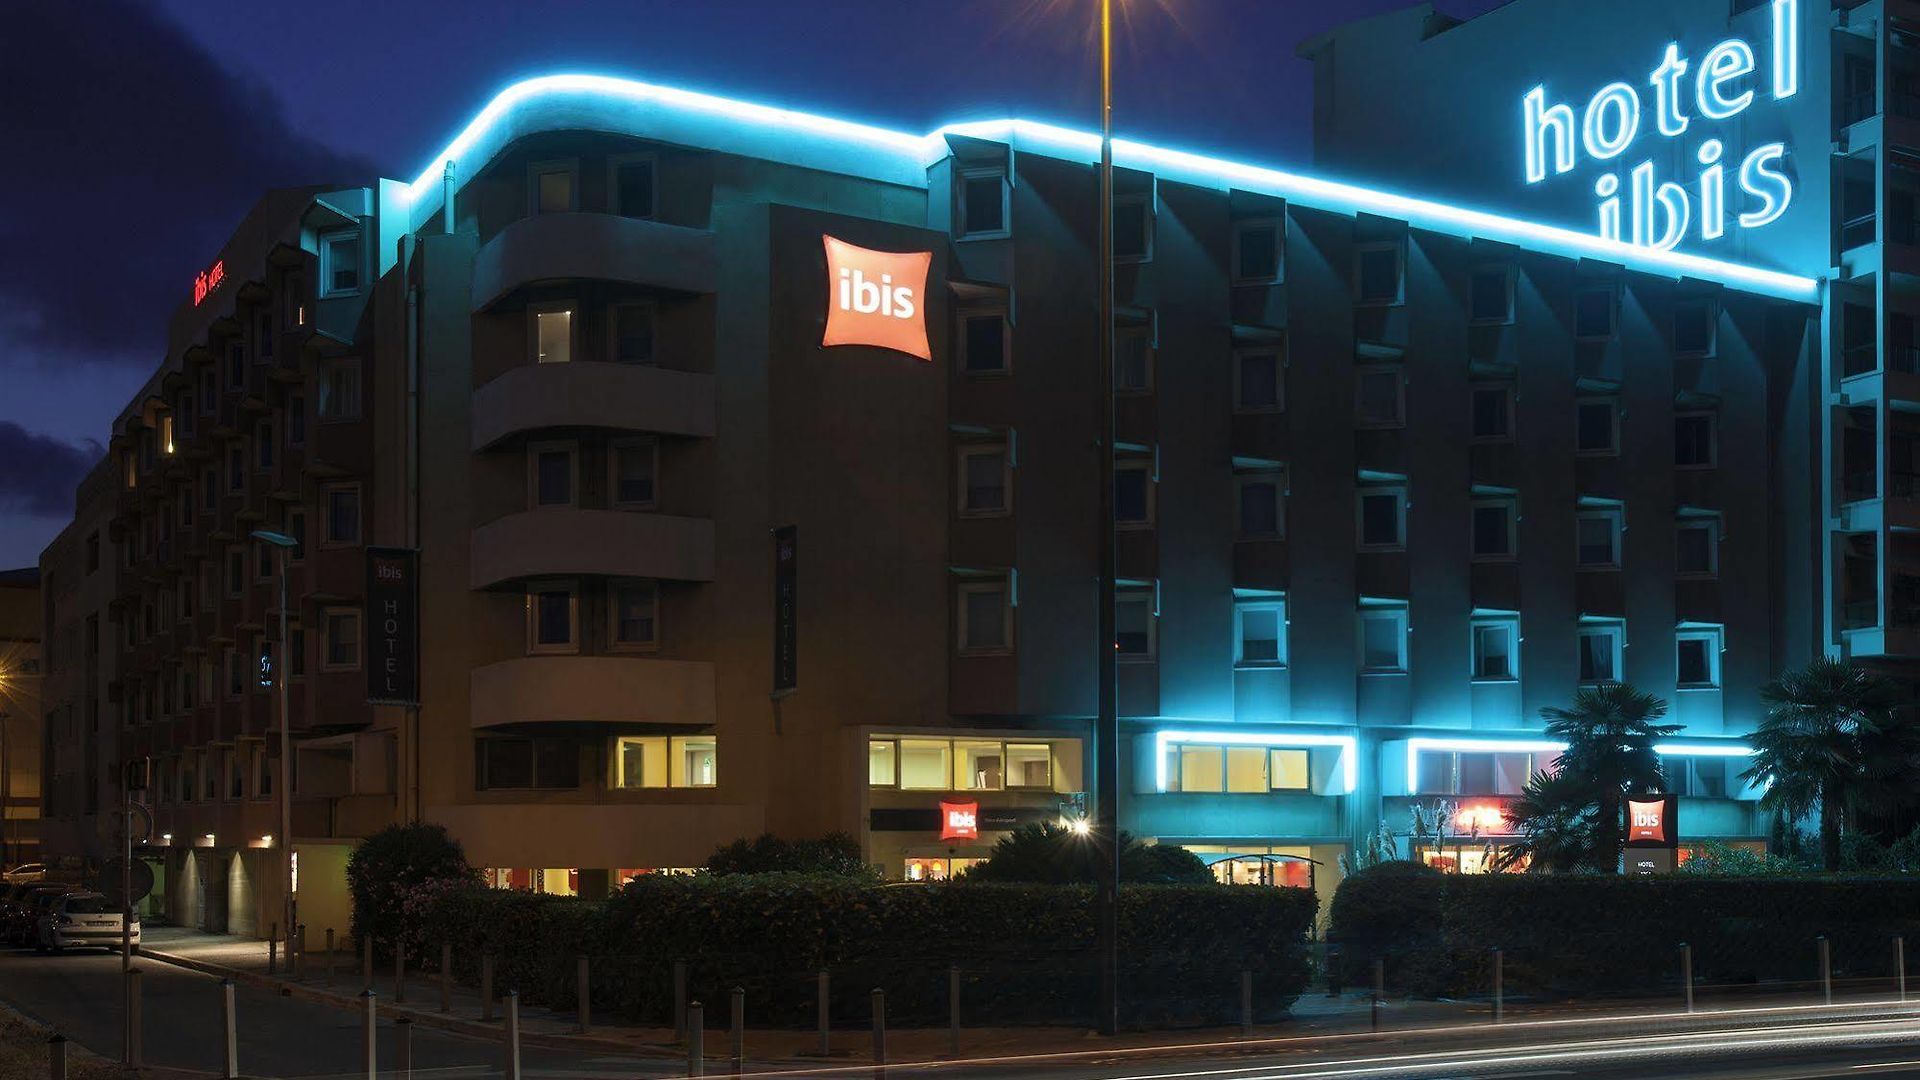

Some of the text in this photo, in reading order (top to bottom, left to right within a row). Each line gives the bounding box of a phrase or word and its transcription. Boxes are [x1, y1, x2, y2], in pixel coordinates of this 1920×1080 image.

[1523, 0, 1798, 184] hotel
[1595, 139, 1792, 252] ibis
[194, 271, 207, 306] ibis
[840, 267, 915, 318] ibis
[377, 565, 402, 580] ibis
[384, 600, 397, 691] HOTEL
[949, 811, 976, 827] ibis
[1633, 811, 1659, 827] ibis
[1637, 860, 1655, 869] HOTEL
